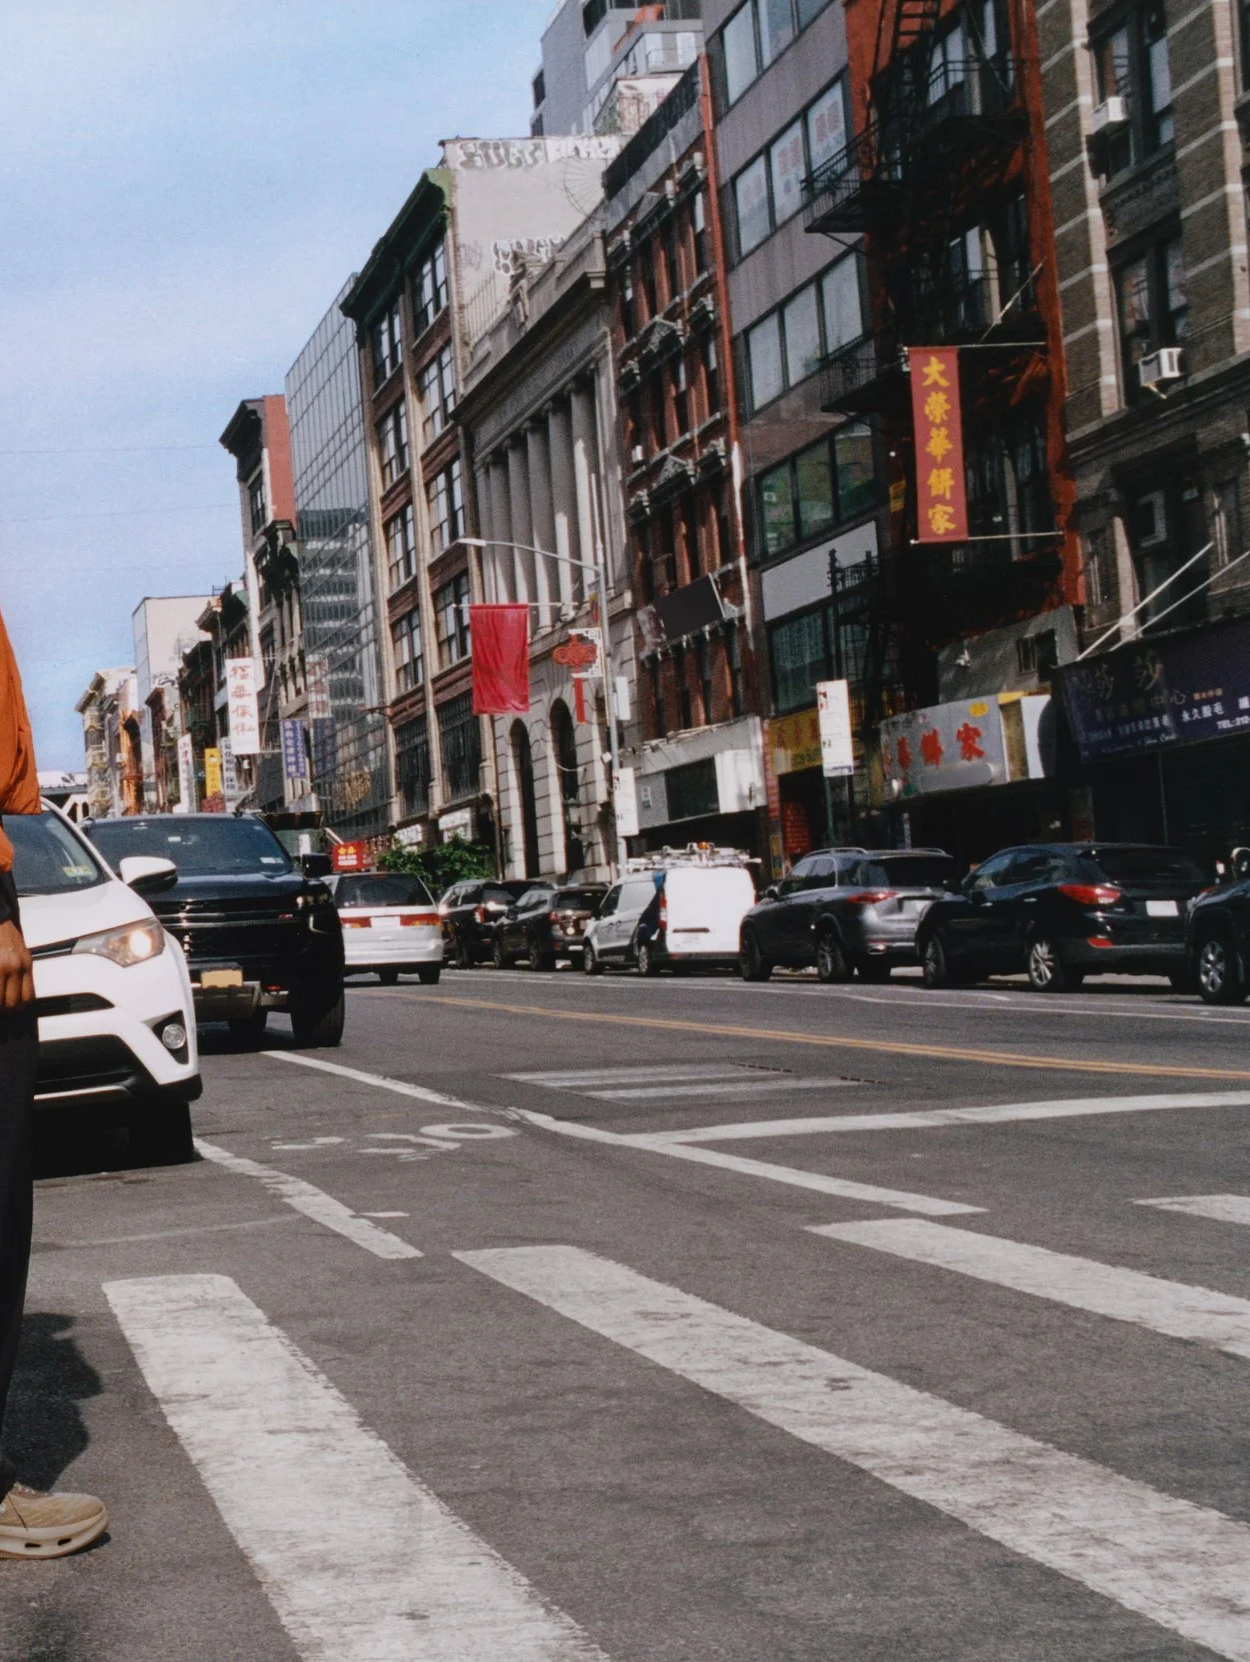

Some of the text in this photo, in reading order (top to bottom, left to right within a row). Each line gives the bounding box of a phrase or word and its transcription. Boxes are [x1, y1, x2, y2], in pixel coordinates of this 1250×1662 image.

[922, 356, 956, 535] 大榮華餅家
